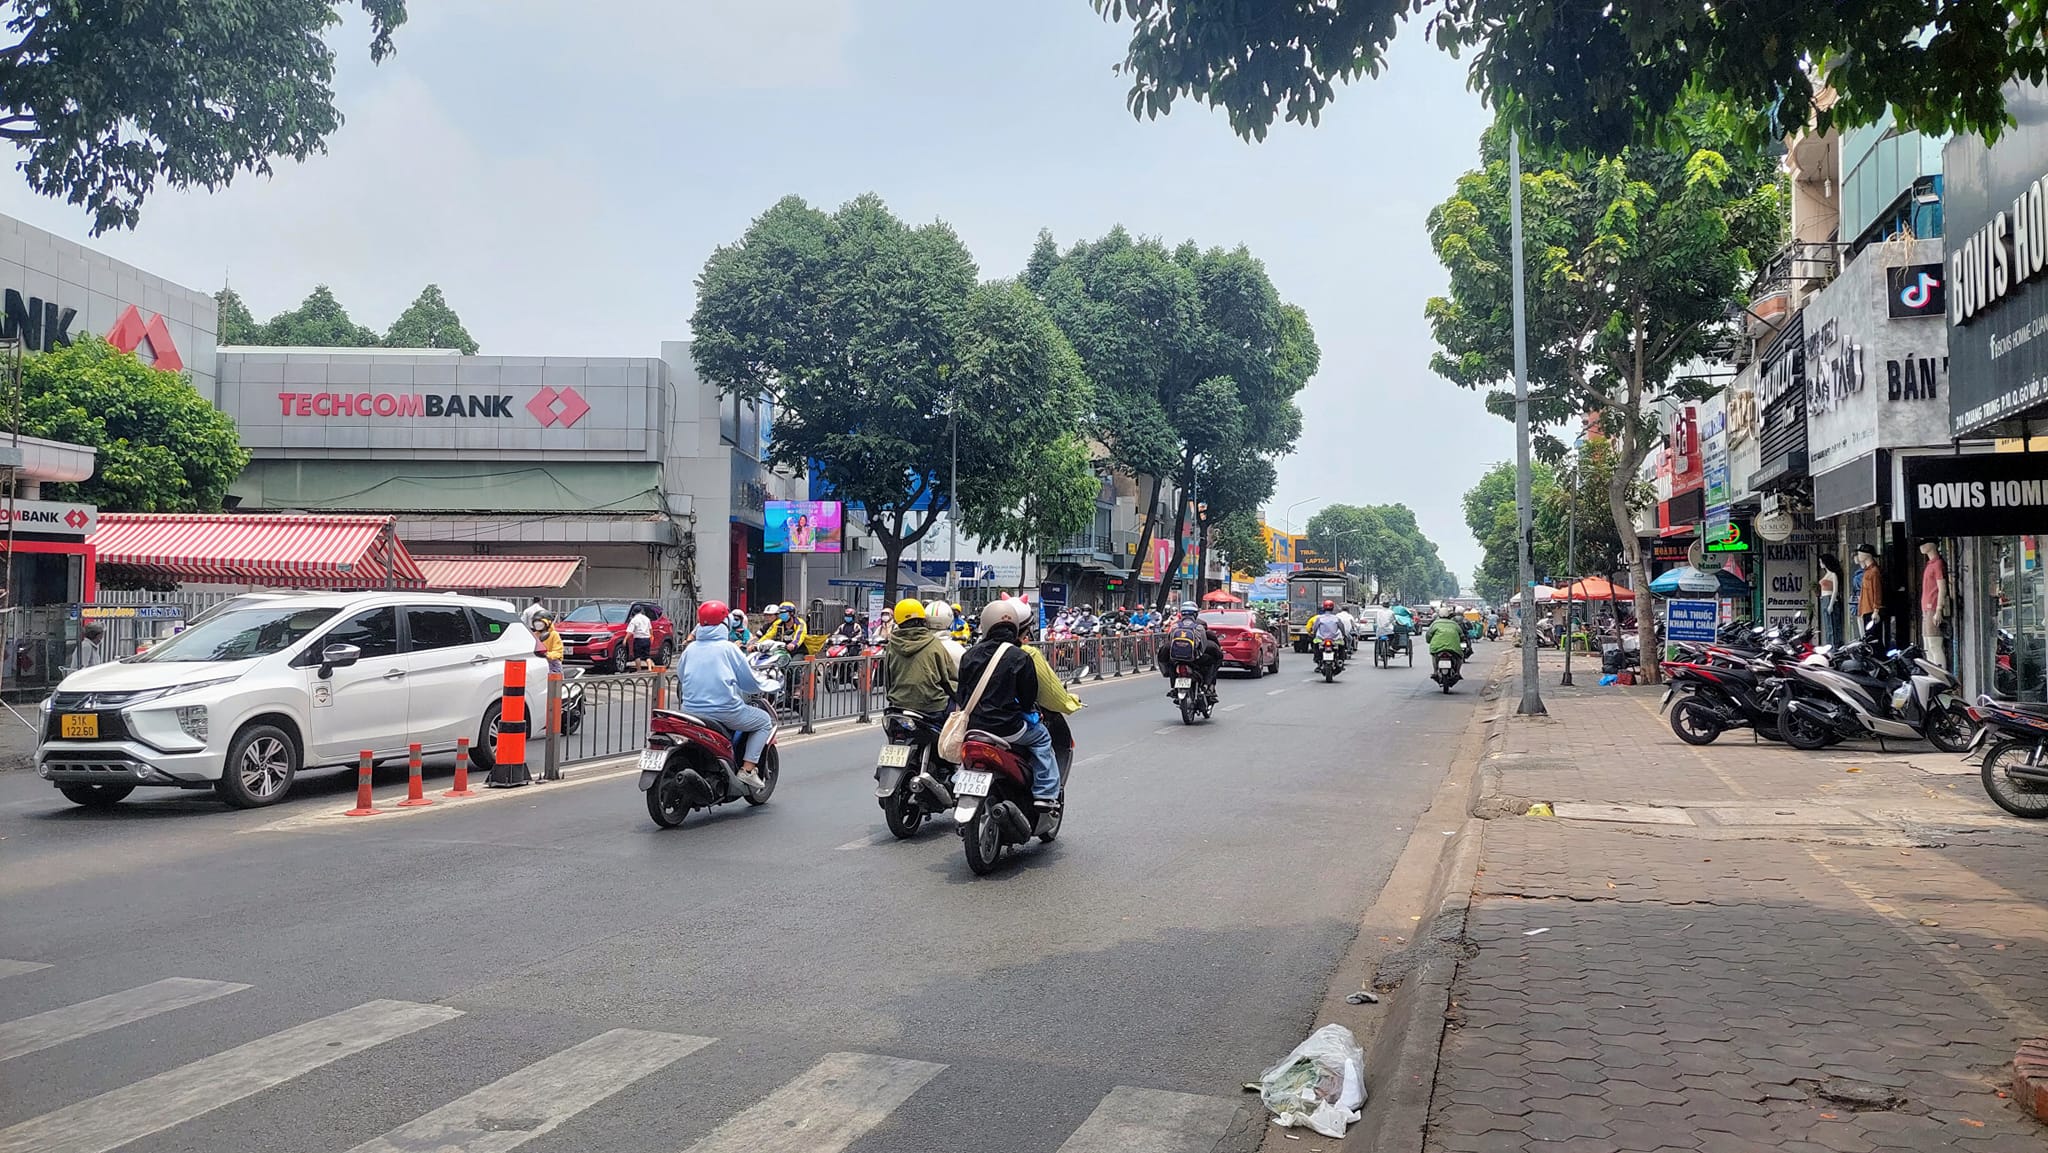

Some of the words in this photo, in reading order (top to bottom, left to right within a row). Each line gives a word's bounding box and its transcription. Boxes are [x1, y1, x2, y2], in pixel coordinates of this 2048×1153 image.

[1952, 210, 2008, 327] BOVIS
[0, 288, 78, 353] NK
[1887, 353, 1937, 401] BÁN
[278, 392, 514, 418] TECHCOMBANK
[1918, 481, 1986, 509] BOVIS
[1767, 545, 1807, 560] KHANH
[1772, 571, 1803, 592] CHÂU
[1672, 608, 1688, 619] NHÀ
[1690, 608, 1714, 620] THUỐC
[1770, 613, 1793, 624] CHYÊN
[1669, 619, 1695, 630] KHANH
[71, 716, 87, 726] 51K
[66, 726, 94, 737] 122.60
